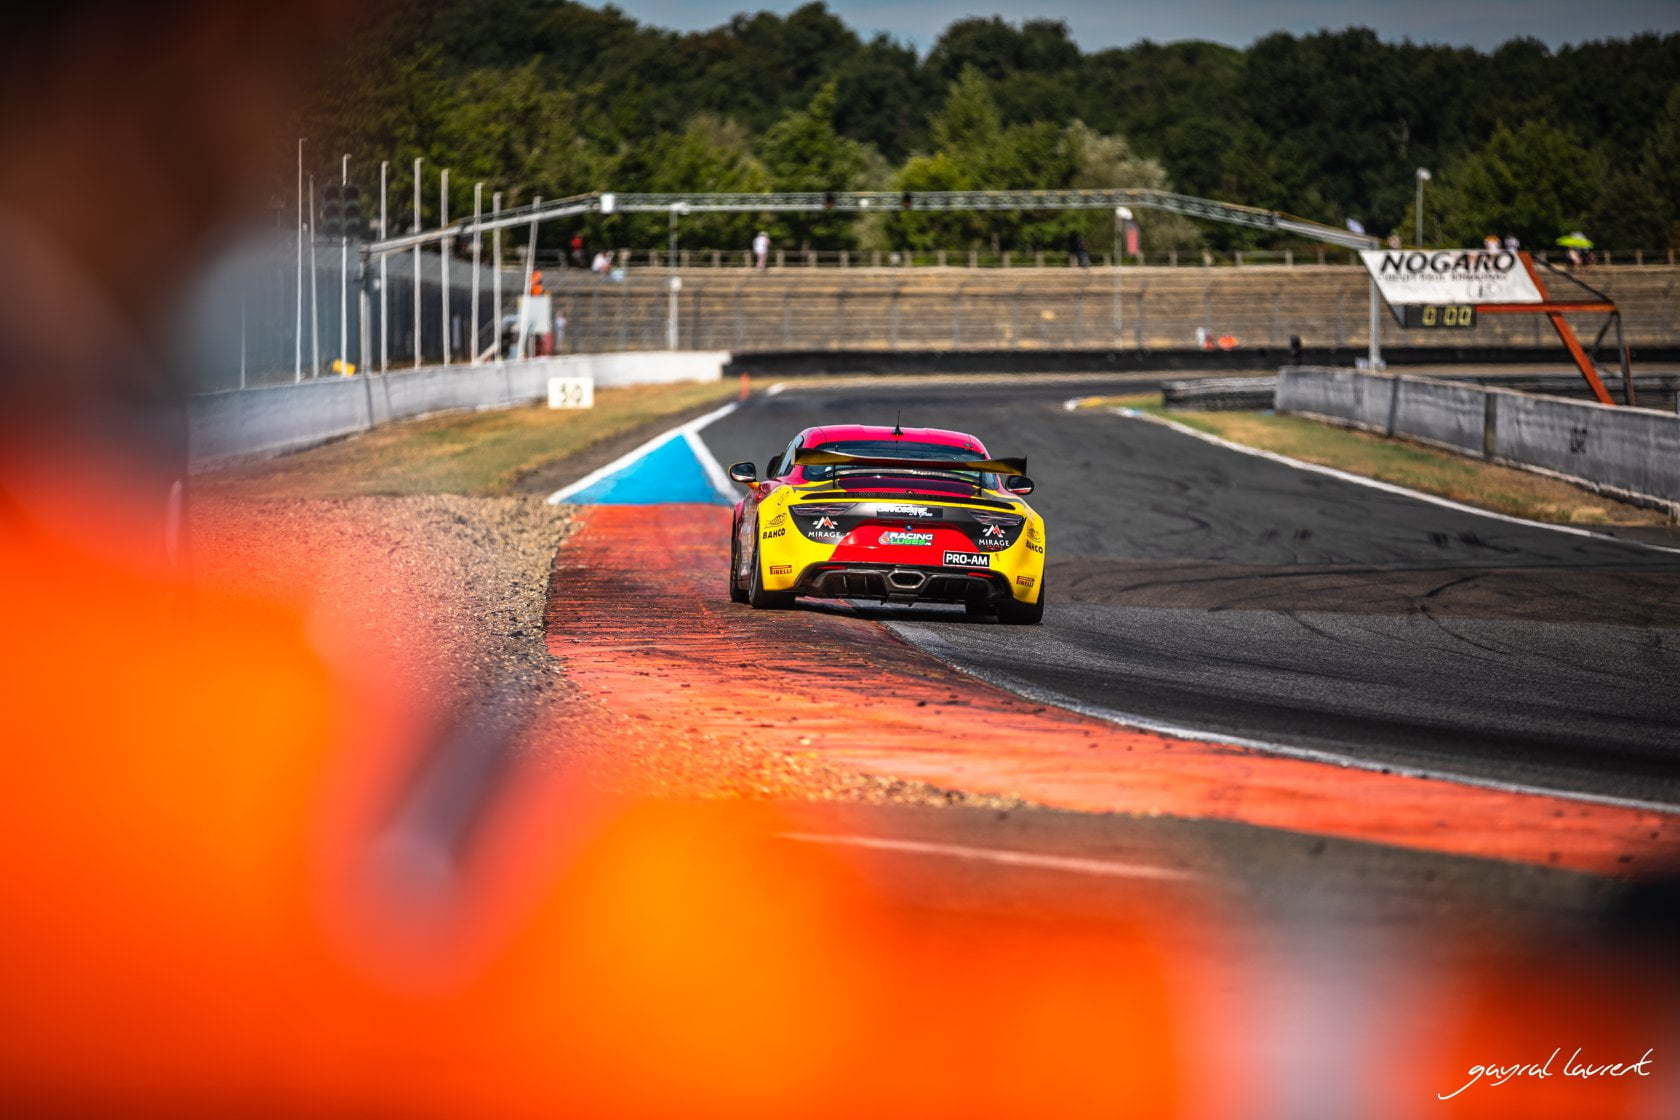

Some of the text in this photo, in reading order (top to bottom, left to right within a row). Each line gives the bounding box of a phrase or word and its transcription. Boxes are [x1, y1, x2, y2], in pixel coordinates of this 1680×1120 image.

[1380, 250, 1515, 274] NOGARO
[762, 528, 786, 539] BAHCO
[889, 532, 933, 540] RACING
[978, 538, 1010, 547] MIRAGE
[945, 553, 989, 566] PRO-AM
[769, 565, 792, 575] PIRELLI
[1016, 575, 1035, 587] PIRELLI
